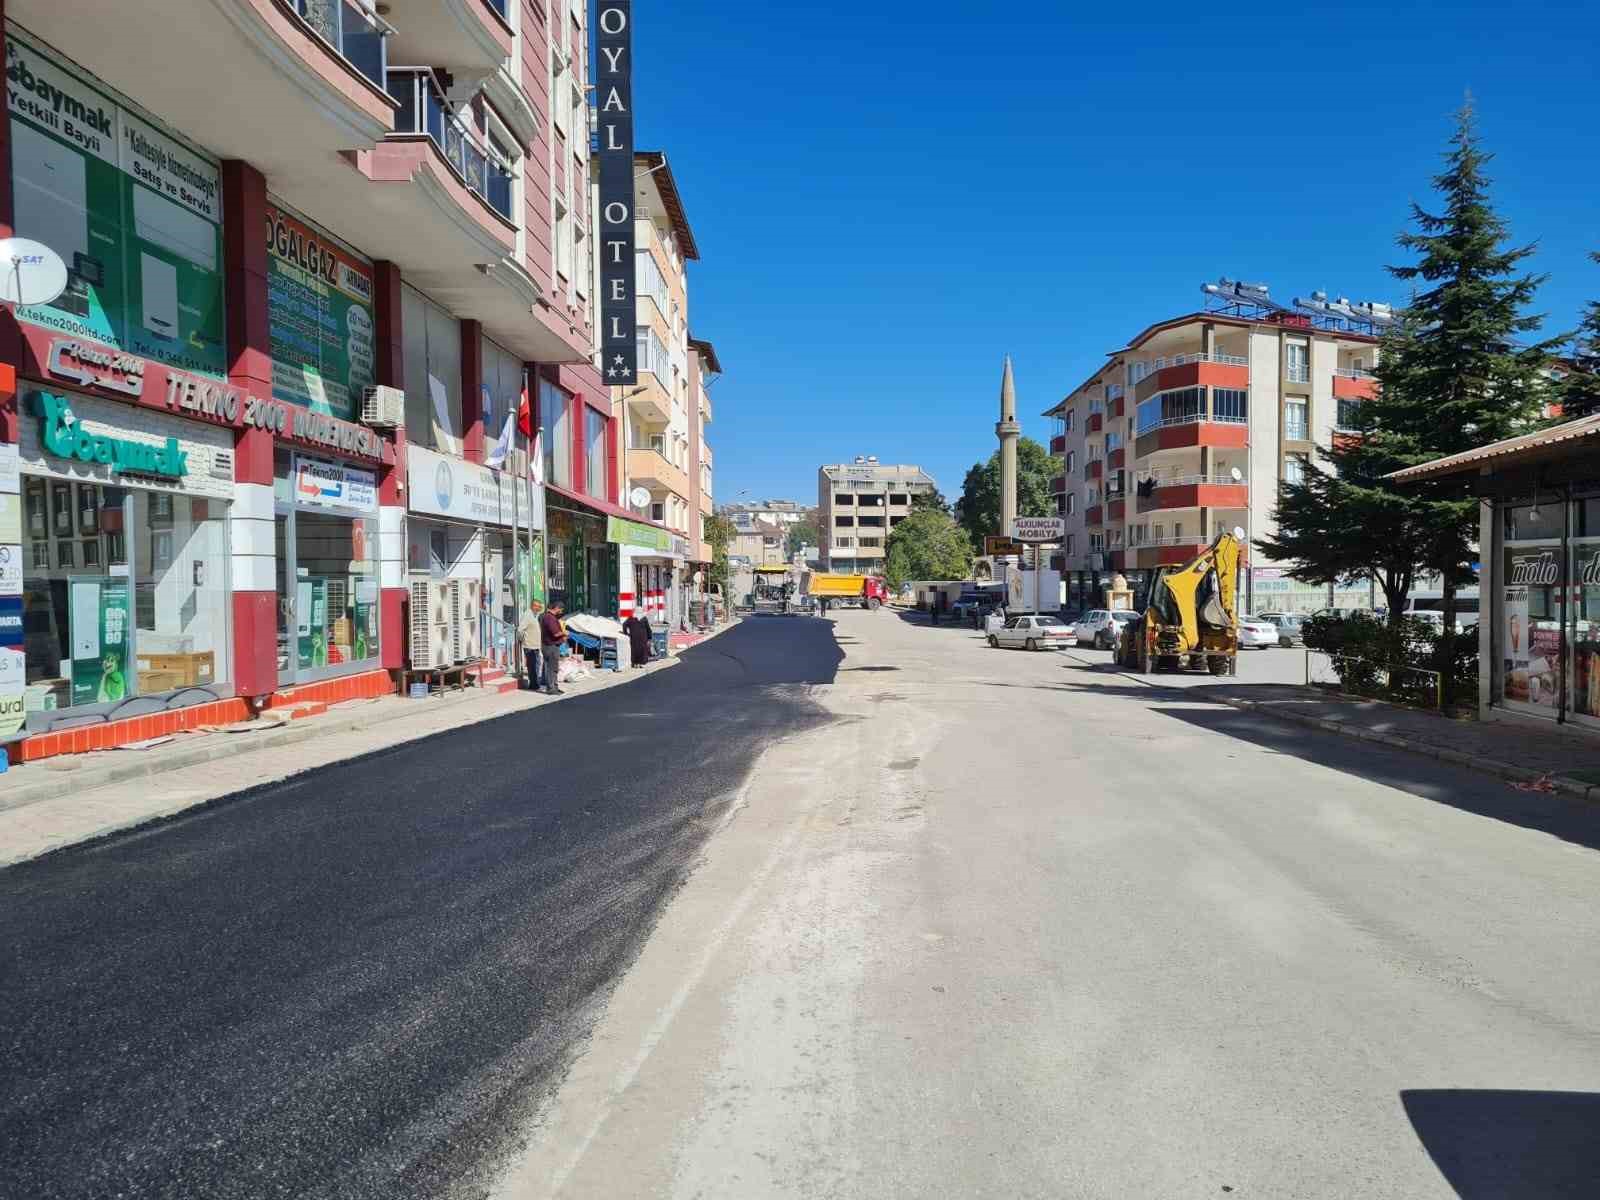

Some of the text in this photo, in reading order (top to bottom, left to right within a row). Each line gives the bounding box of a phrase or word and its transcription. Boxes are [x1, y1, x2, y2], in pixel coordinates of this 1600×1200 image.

[7, 87, 100, 152] Yetkili Bayii
[20, 61, 112, 139] baymak
[134, 160, 211, 214] Satış ve Servis
[600, 8, 628, 338] OYAL OTEL
[166, 370, 240, 421] TEKNO
[243, 394, 286, 433] 2000
